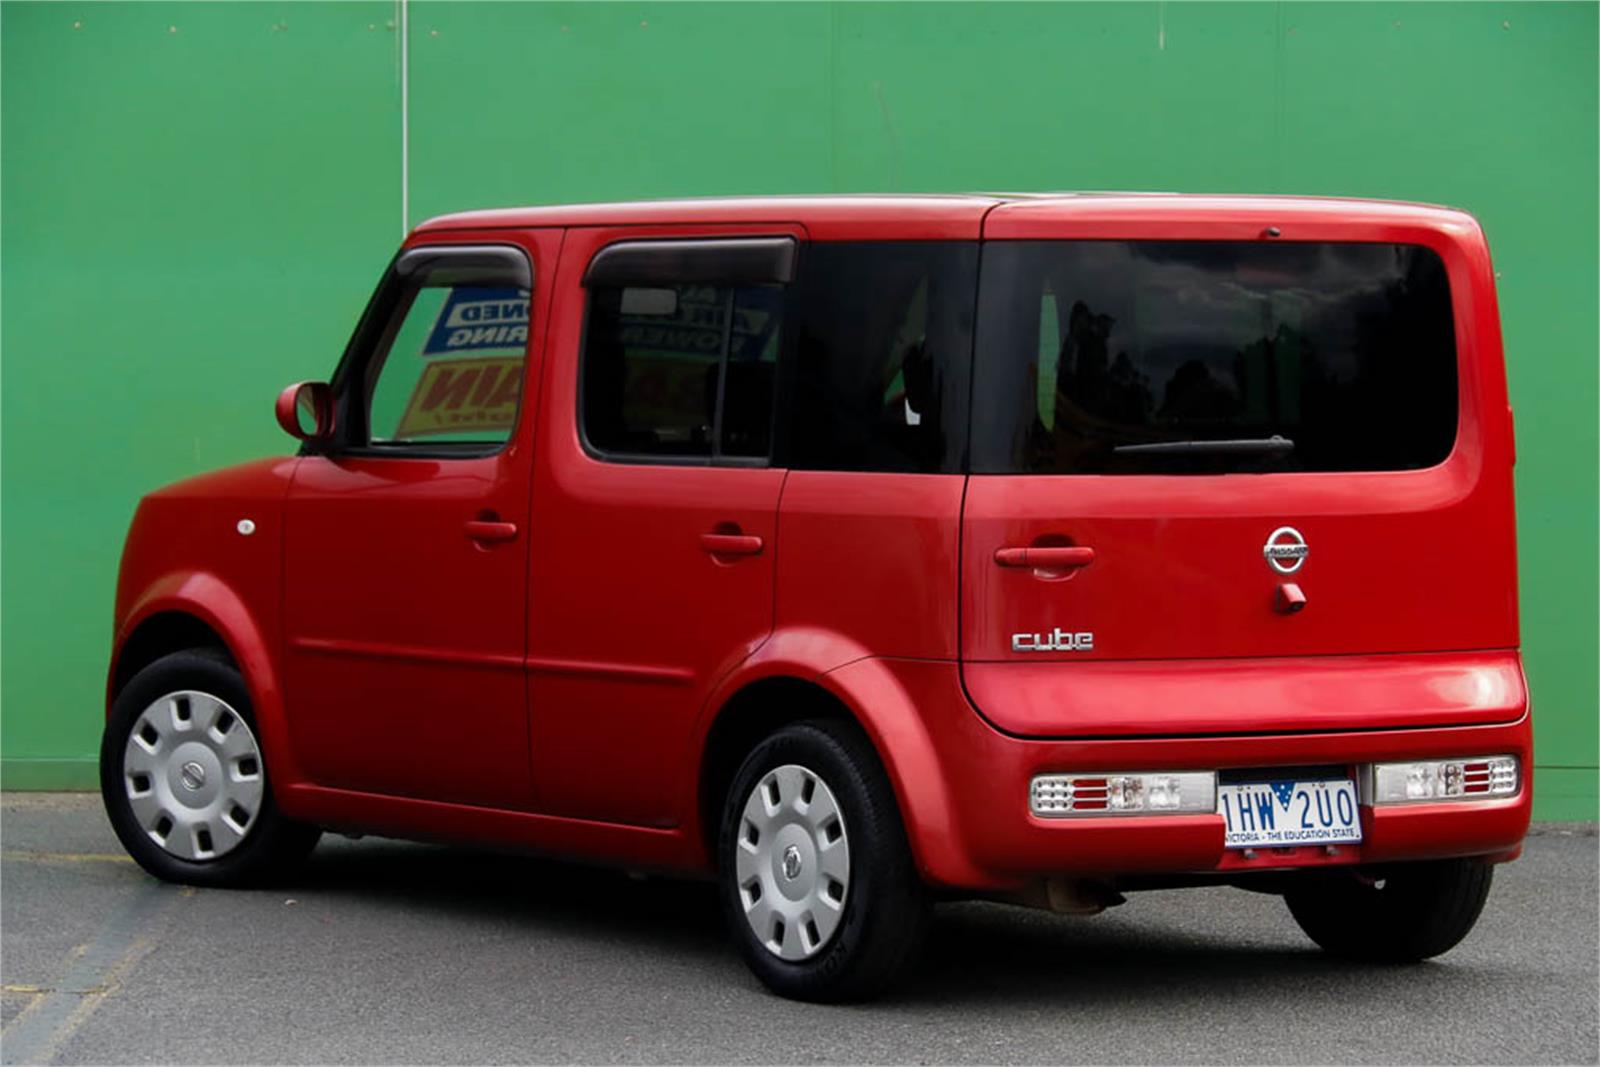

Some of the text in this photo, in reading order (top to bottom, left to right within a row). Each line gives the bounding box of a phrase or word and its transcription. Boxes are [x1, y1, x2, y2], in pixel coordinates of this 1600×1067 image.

[1012, 628, 1094, 651] cube
[1221, 791, 1275, 832] 1HW
[1267, 832, 1282, 841] THE
[1284, 830, 1331, 840] EDUCATION
[1332, 828, 1355, 838] STATE
